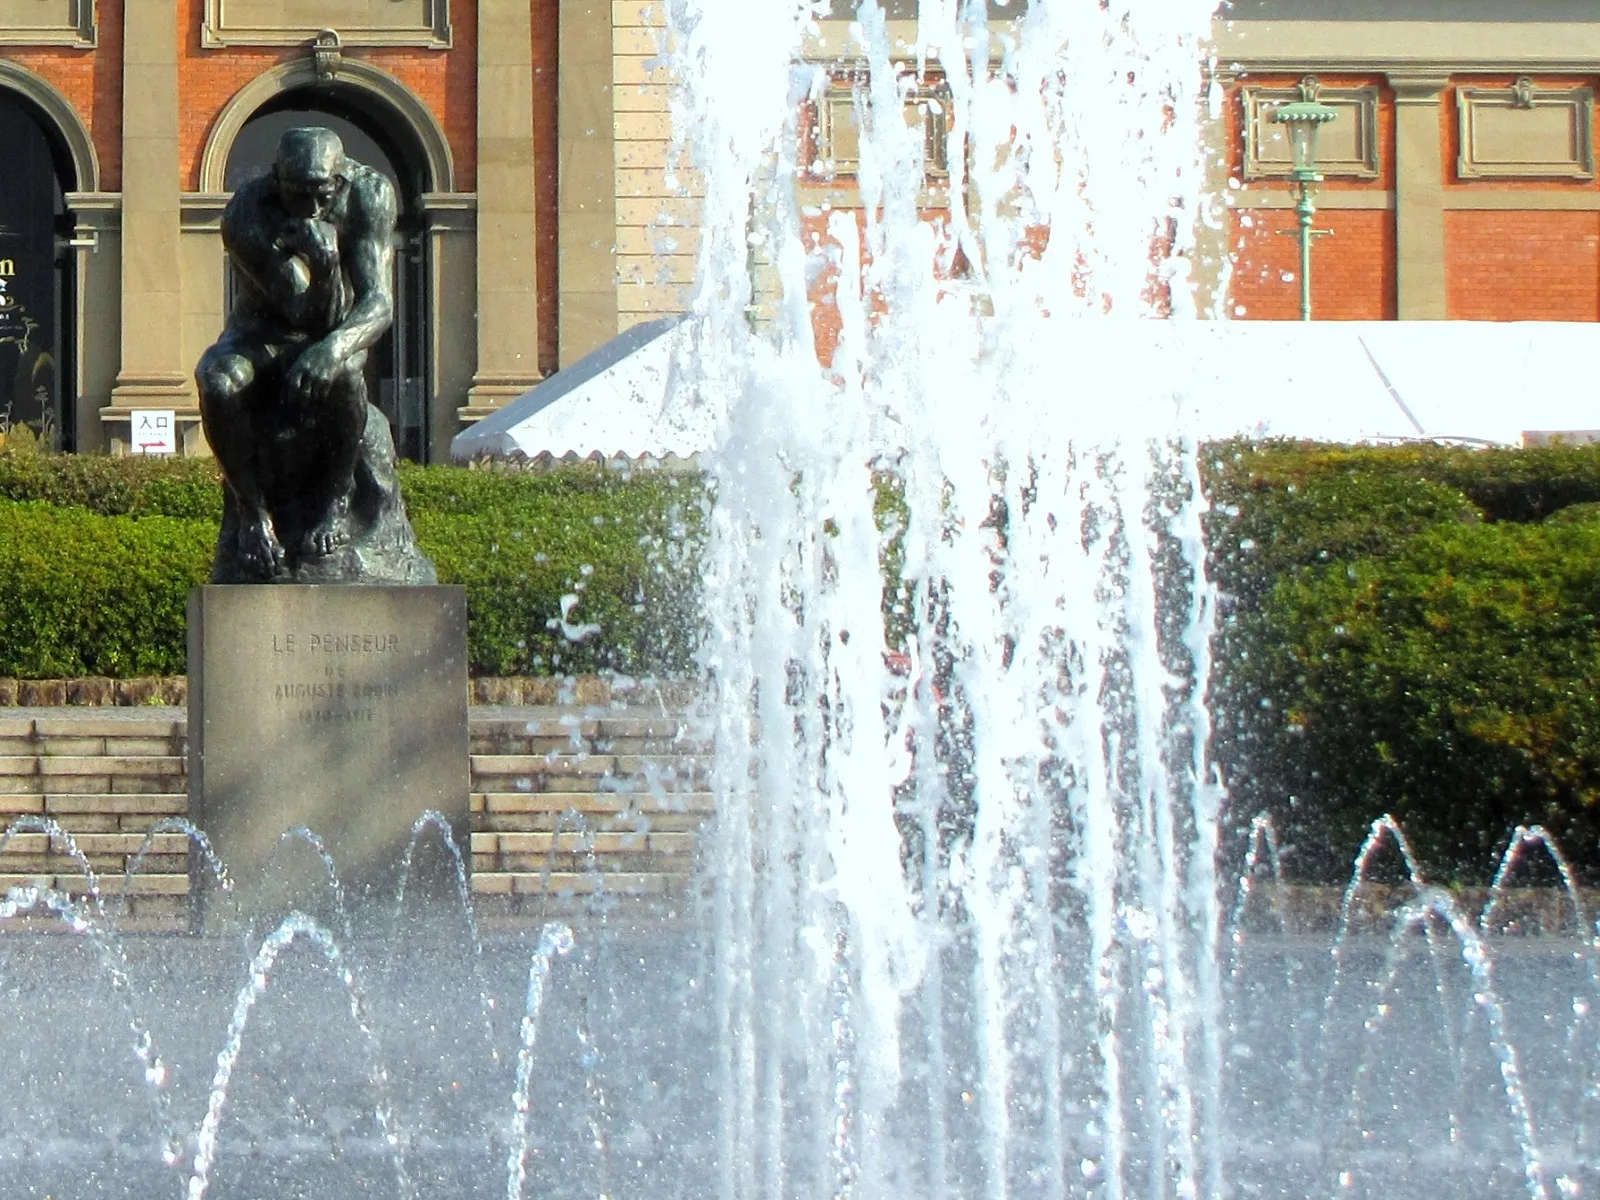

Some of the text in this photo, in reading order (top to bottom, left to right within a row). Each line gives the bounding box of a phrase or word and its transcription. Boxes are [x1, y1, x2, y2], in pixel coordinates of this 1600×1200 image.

[139, 415, 168, 429] 入口
[272, 633, 399, 653] LE PENSEUR
[275, 683, 345, 698] AUGUSTE
